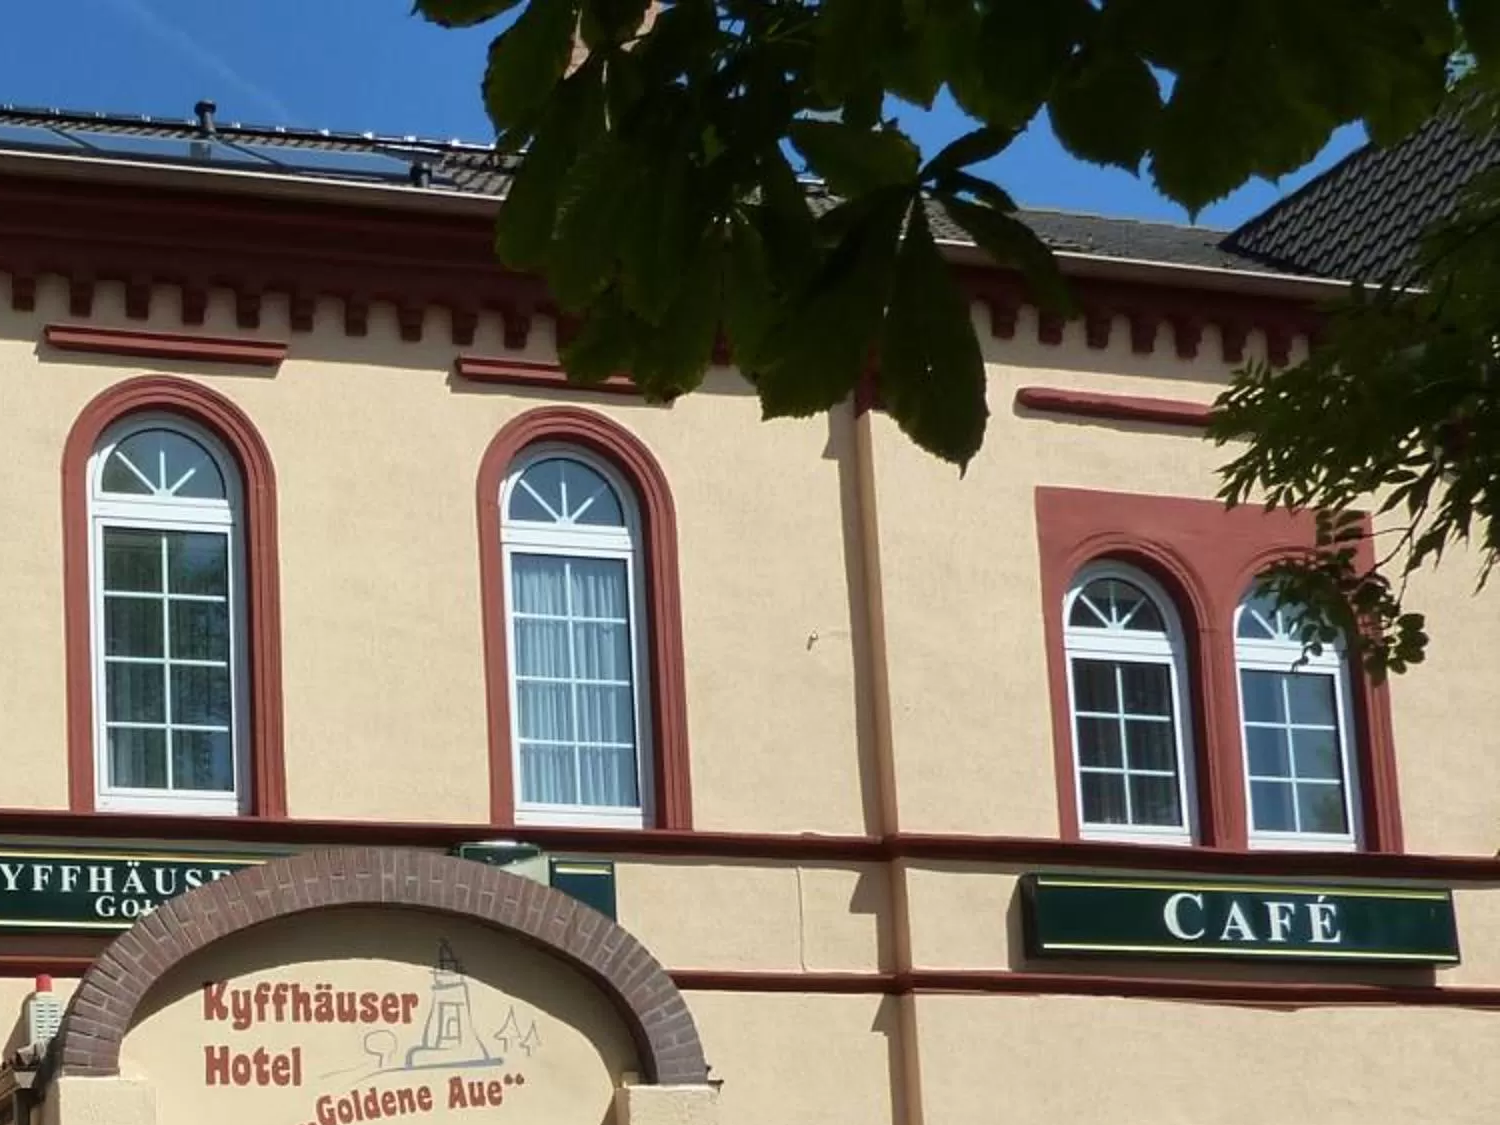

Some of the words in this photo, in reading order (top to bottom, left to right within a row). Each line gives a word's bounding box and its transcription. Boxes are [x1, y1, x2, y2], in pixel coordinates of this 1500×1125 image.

[1162, 891, 1342, 944] CAFÉ
[202, 979, 419, 1030] Kyffhäuser
[203, 1044, 302, 1087] Hotel
